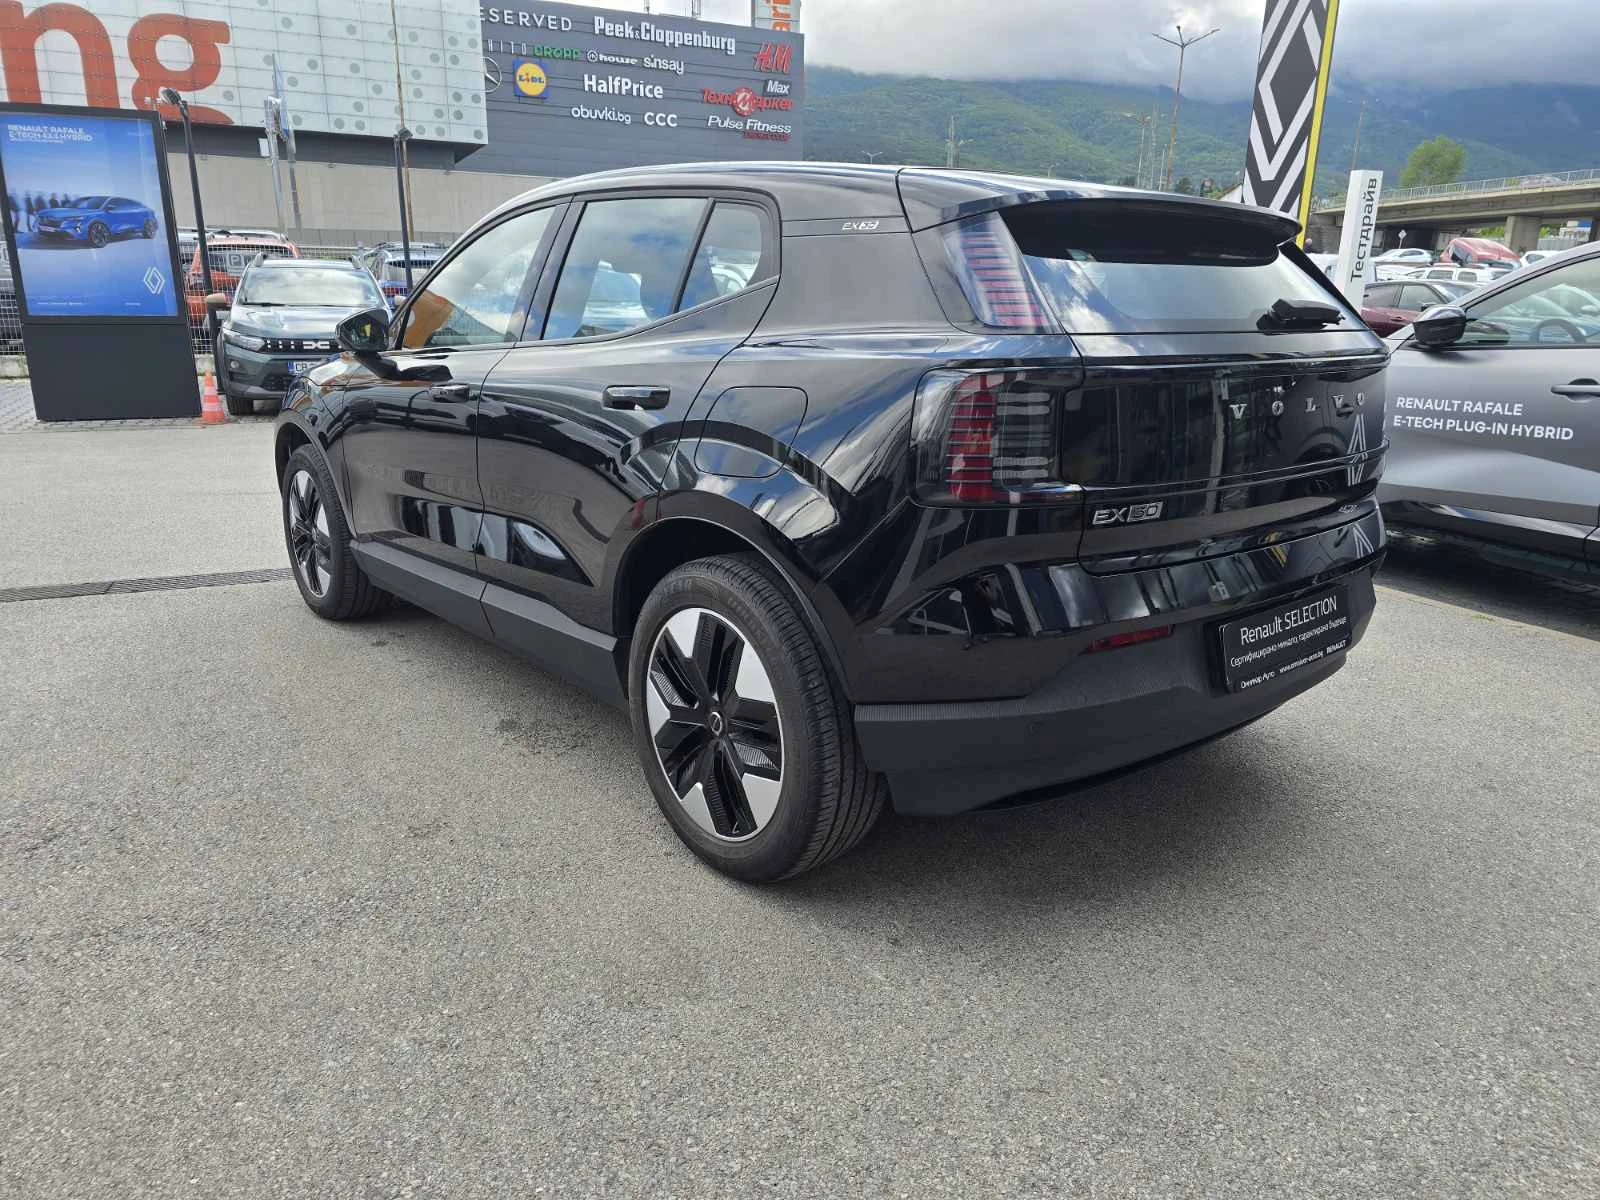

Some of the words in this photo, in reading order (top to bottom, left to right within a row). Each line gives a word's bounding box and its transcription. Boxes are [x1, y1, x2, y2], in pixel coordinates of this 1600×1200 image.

[753, 41, 792, 74] H&M
[584, 74, 664, 99] HalfPrice
[767, 79, 791, 94] Max
[571, 105, 632, 124] obuvki.bg
[644, 112, 678, 127] CCC
[708, 115, 744, 130] Pulse
[746, 119, 792, 133] Fitness
[1351, 178, 1377, 282] Тестдрайв
[1229, 392, 1365, 420] VOLVO
[1396, 396, 1462, 412] RENAULT
[1463, 401, 1524, 416] RAFALE
[1393, 415, 1444, 431] E-TECH
[1446, 420, 1508, 436] PLUG-IN
[1511, 424, 1574, 441] HYBRID
[1240, 616, 1283, 646] Renault
[1285, 595, 1337, 630] SELECTION
